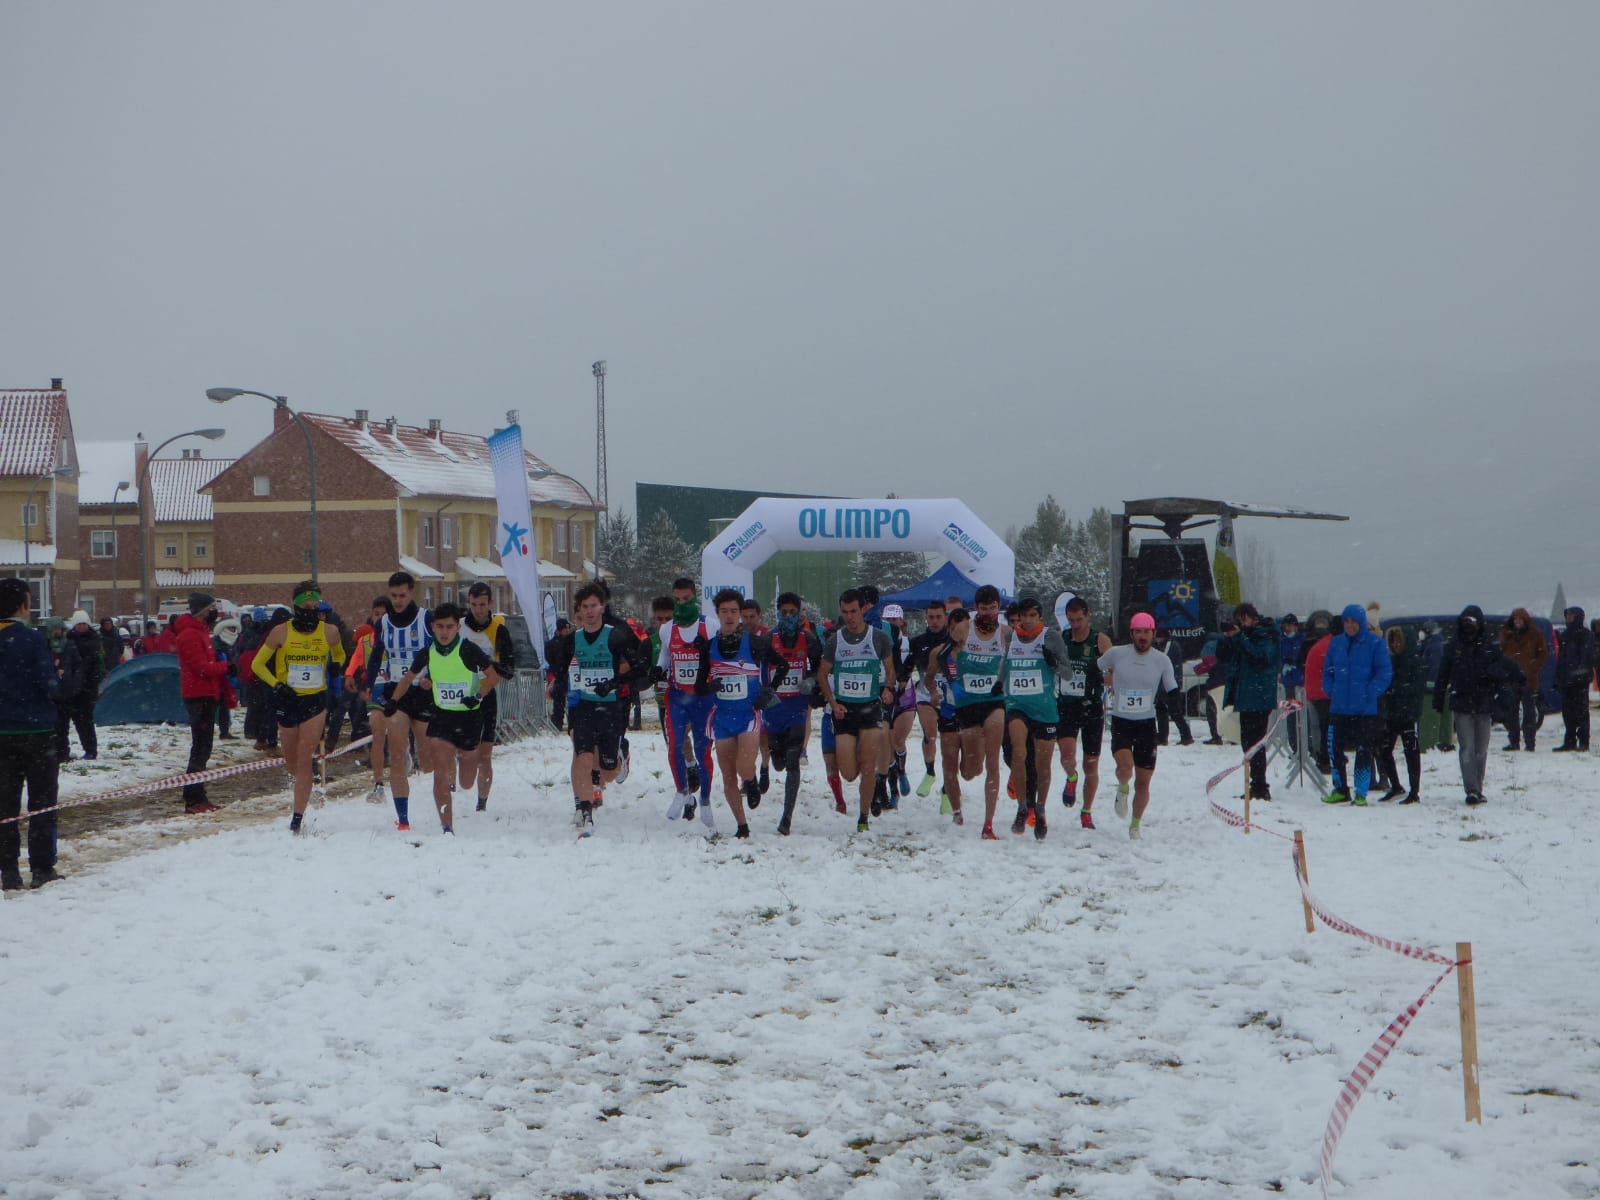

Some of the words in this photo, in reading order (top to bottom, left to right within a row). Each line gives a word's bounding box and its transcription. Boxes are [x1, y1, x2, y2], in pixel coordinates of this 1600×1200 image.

[799, 508, 911, 539] OLIMPO
[735, 521, 764, 547] OLIMPO
[960, 533, 988, 559] OLIMPO
[966, 654, 994, 663] ATLEET
[841, 660, 868, 668] ATLEET
[302, 672, 310, 681] 3
[784, 677, 798, 686] 03
[844, 681, 866, 691] 501
[970, 677, 992, 688] 404
[1014, 678, 1036, 688] 401
[1070, 681, 1084, 690] 14
[441, 689, 464, 700] 304
[1127, 697, 1143, 706] 31
